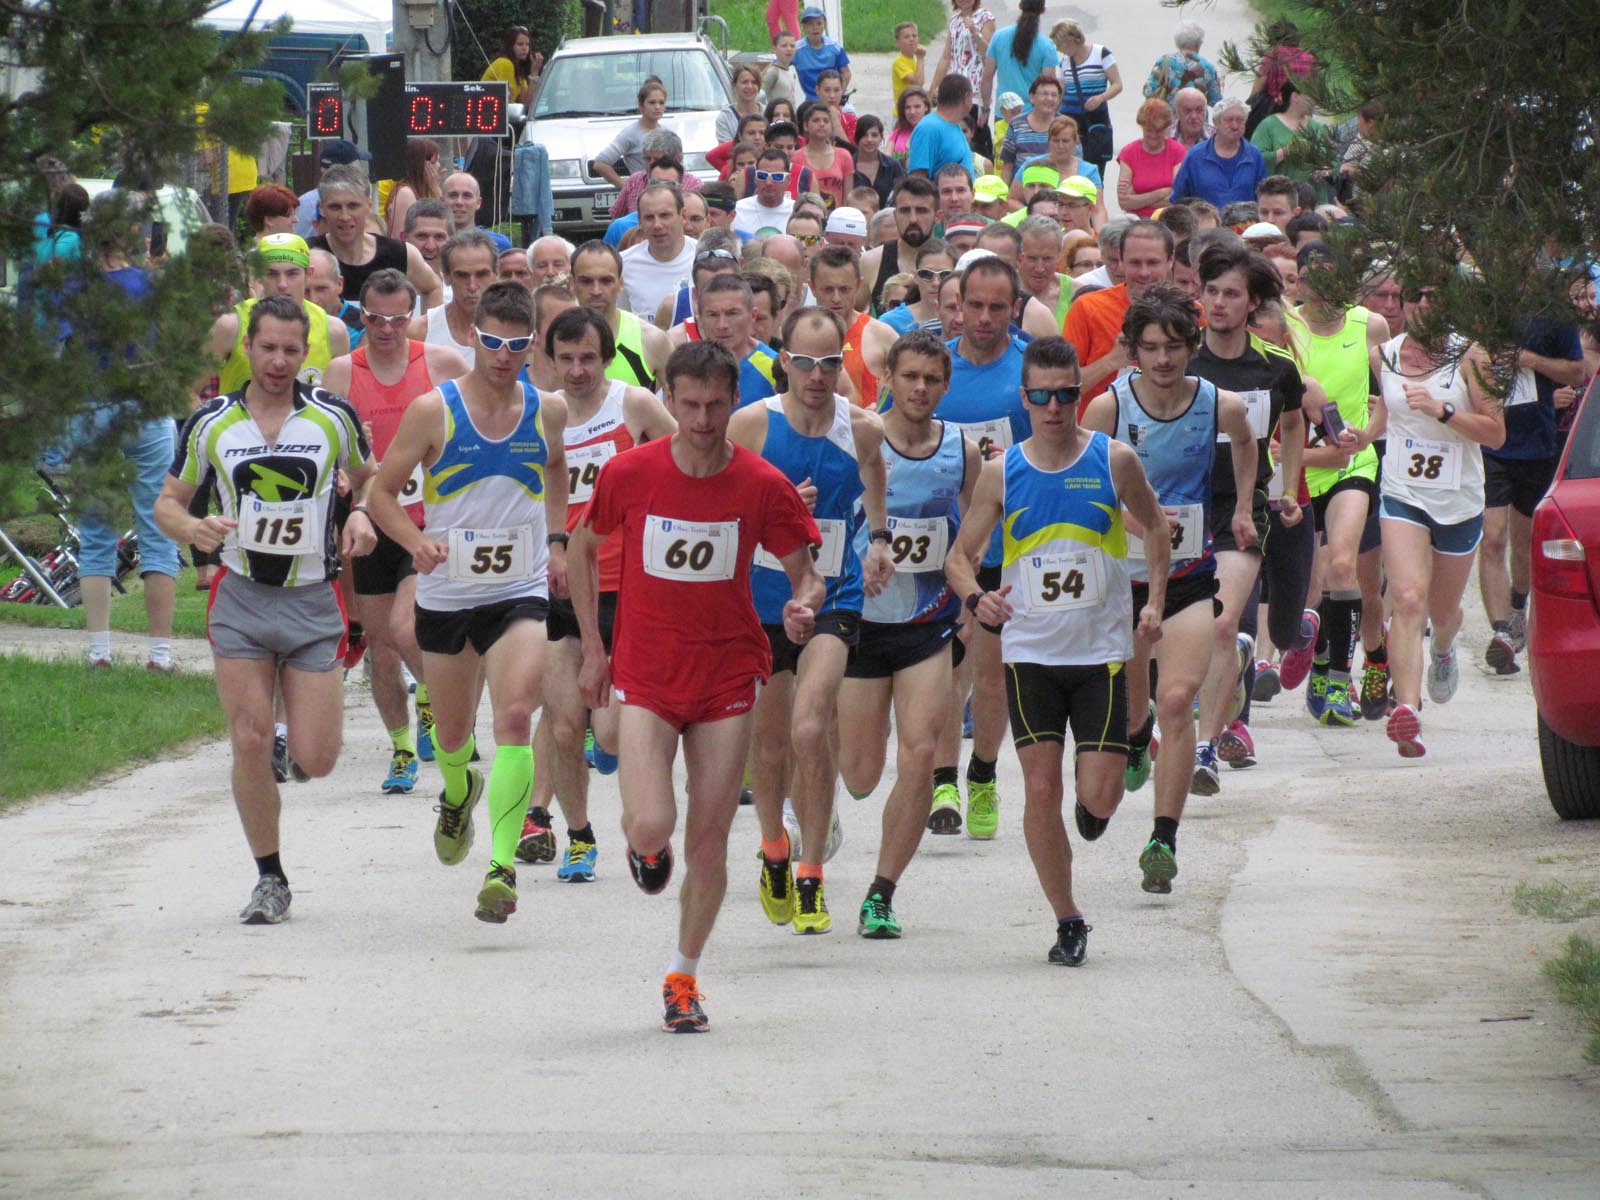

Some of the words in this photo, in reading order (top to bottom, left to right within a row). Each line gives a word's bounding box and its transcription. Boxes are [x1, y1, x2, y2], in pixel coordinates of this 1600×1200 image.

[463, 84, 485, 92] Sek.
[318, 98, 339, 132] 0
[588, 419, 616, 434] Ferenc
[1407, 453, 1444, 479] 38
[254, 517, 304, 546] 115
[470, 544, 513, 574] 55
[665, 539, 714, 571] 60
[892, 535, 931, 564] 93
[1041, 569, 1085, 602] 54
